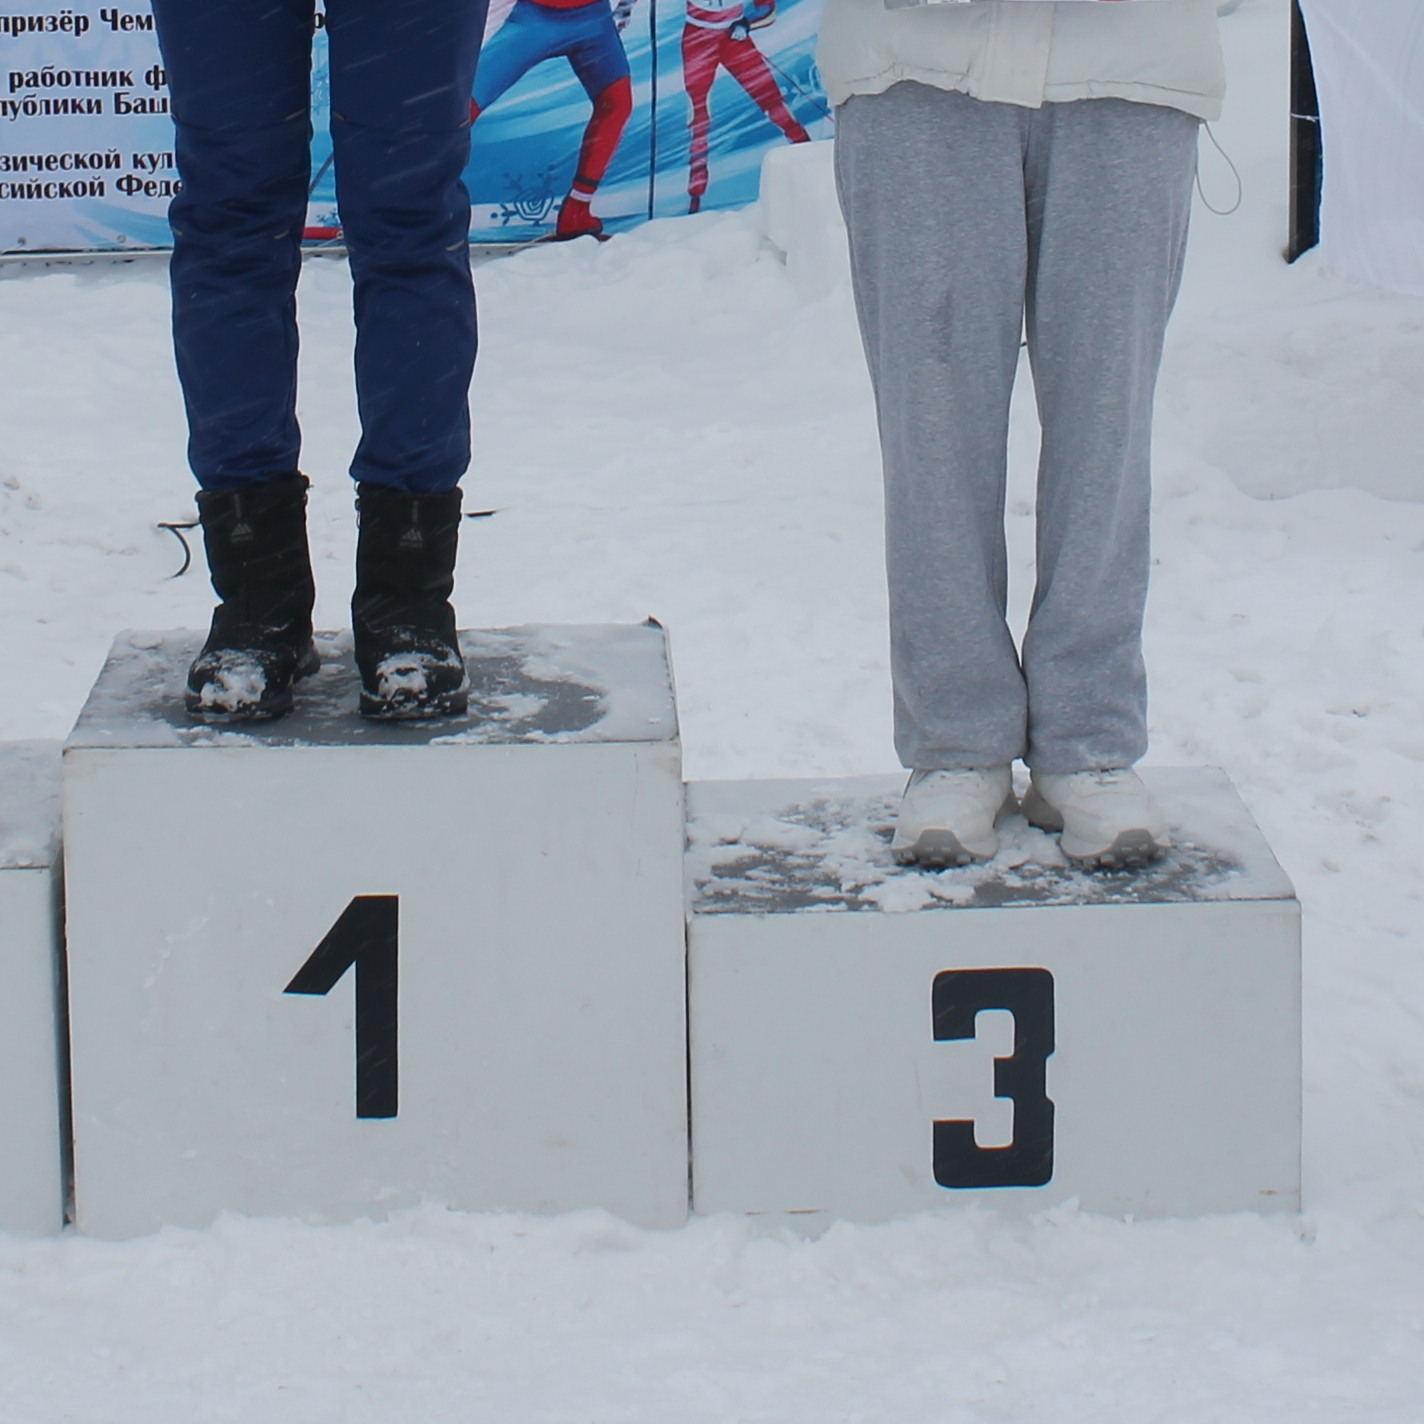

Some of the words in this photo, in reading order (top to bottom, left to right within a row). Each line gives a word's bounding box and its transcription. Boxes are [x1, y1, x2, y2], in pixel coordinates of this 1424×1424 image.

[9, 66, 134, 93] работник
[282, 893, 399, 1119] 1
[931, 966, 1054, 1189] 3
